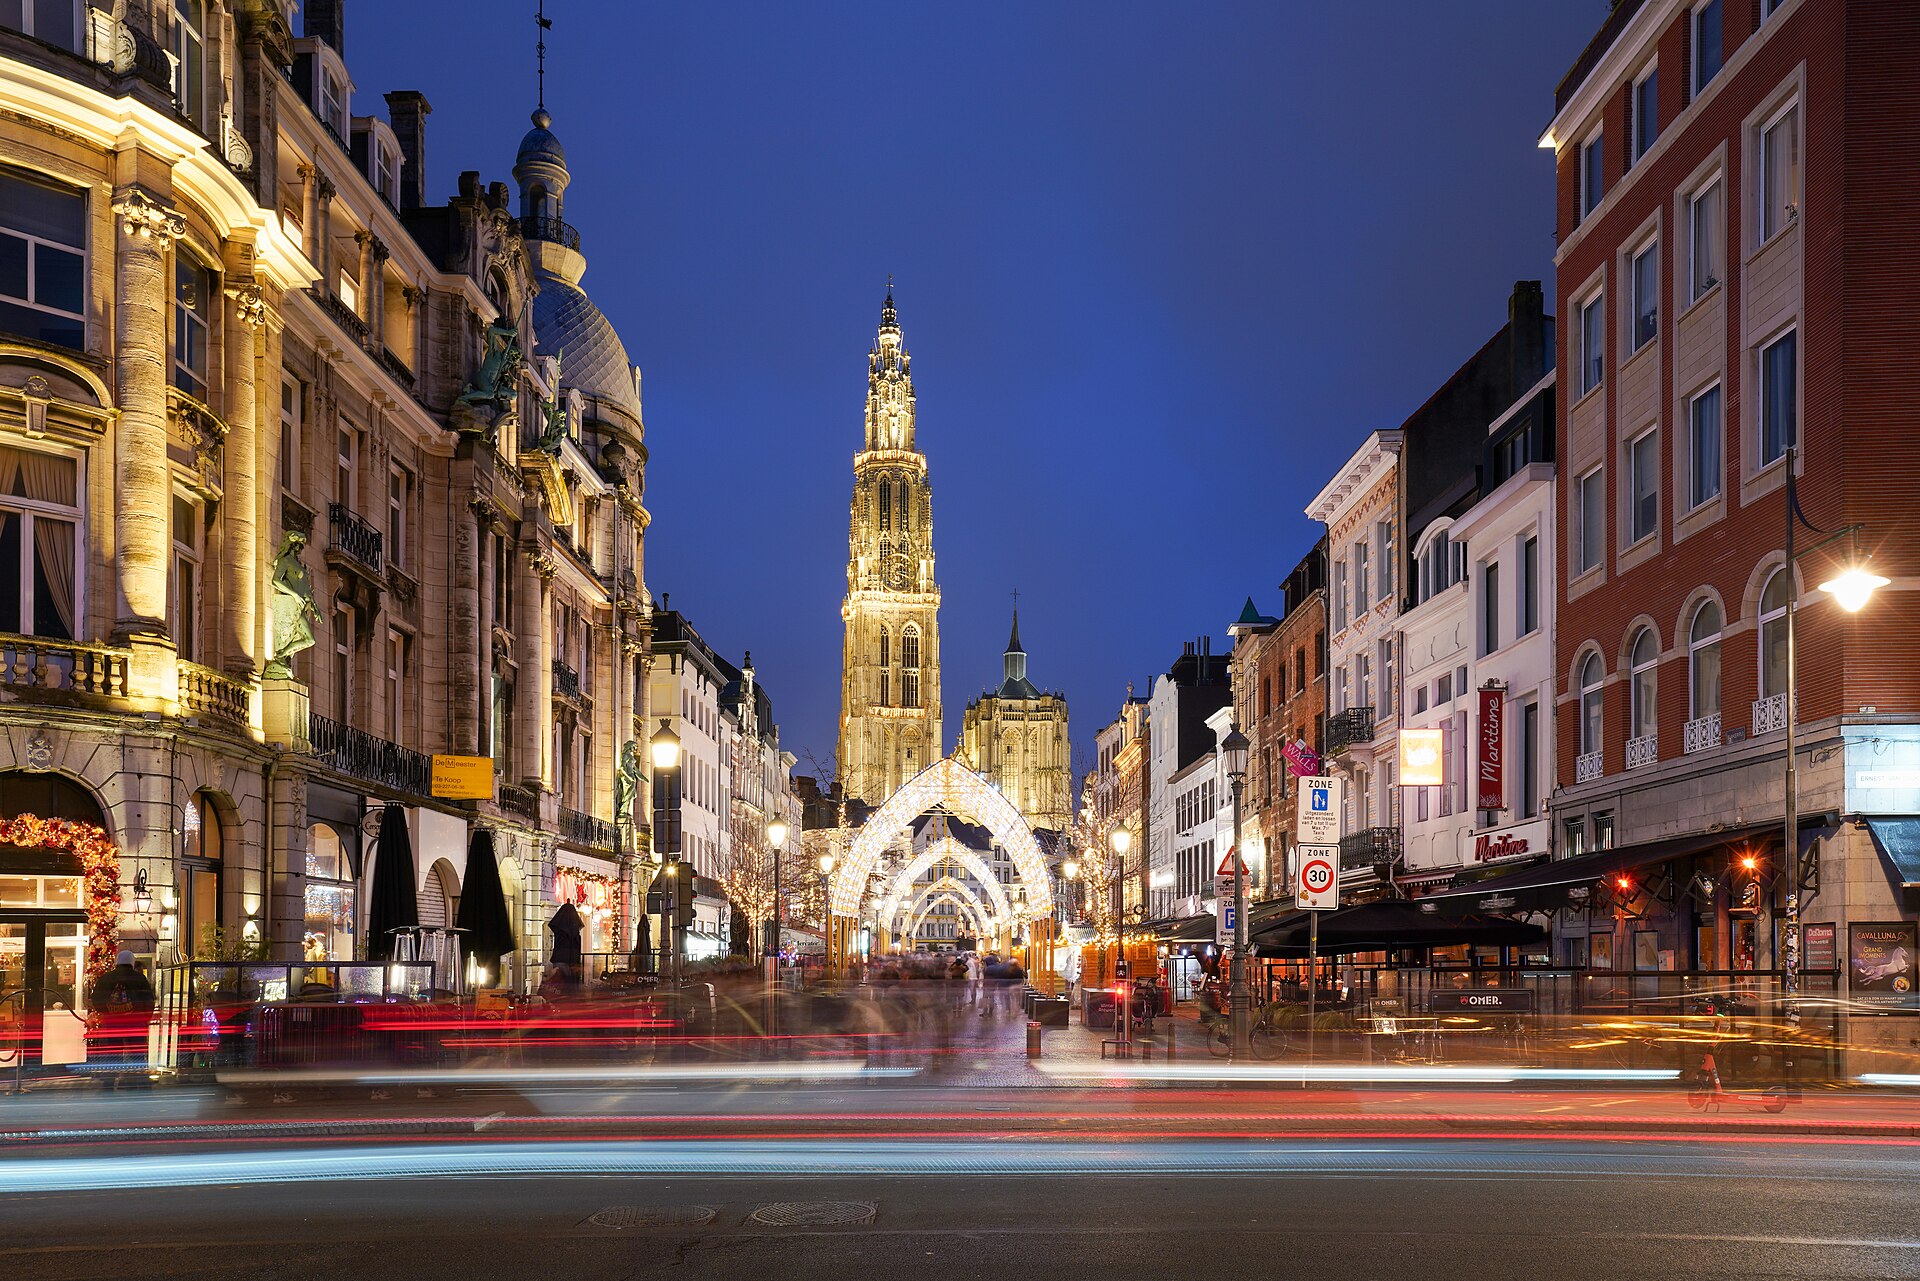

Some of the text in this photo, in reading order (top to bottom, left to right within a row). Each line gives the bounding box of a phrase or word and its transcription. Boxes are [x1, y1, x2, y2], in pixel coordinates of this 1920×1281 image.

[1481, 697, 1500, 782] Maritime
[1287, 744, 1316, 771] WALLS
[1309, 780, 1333, 788] ZONE
[1475, 834, 1528, 862] Maritime
[1310, 870, 1326, 882] 30
[1857, 932, 1897, 940] CAVALLUNA
[1469, 996, 1503, 1005] OMER.
